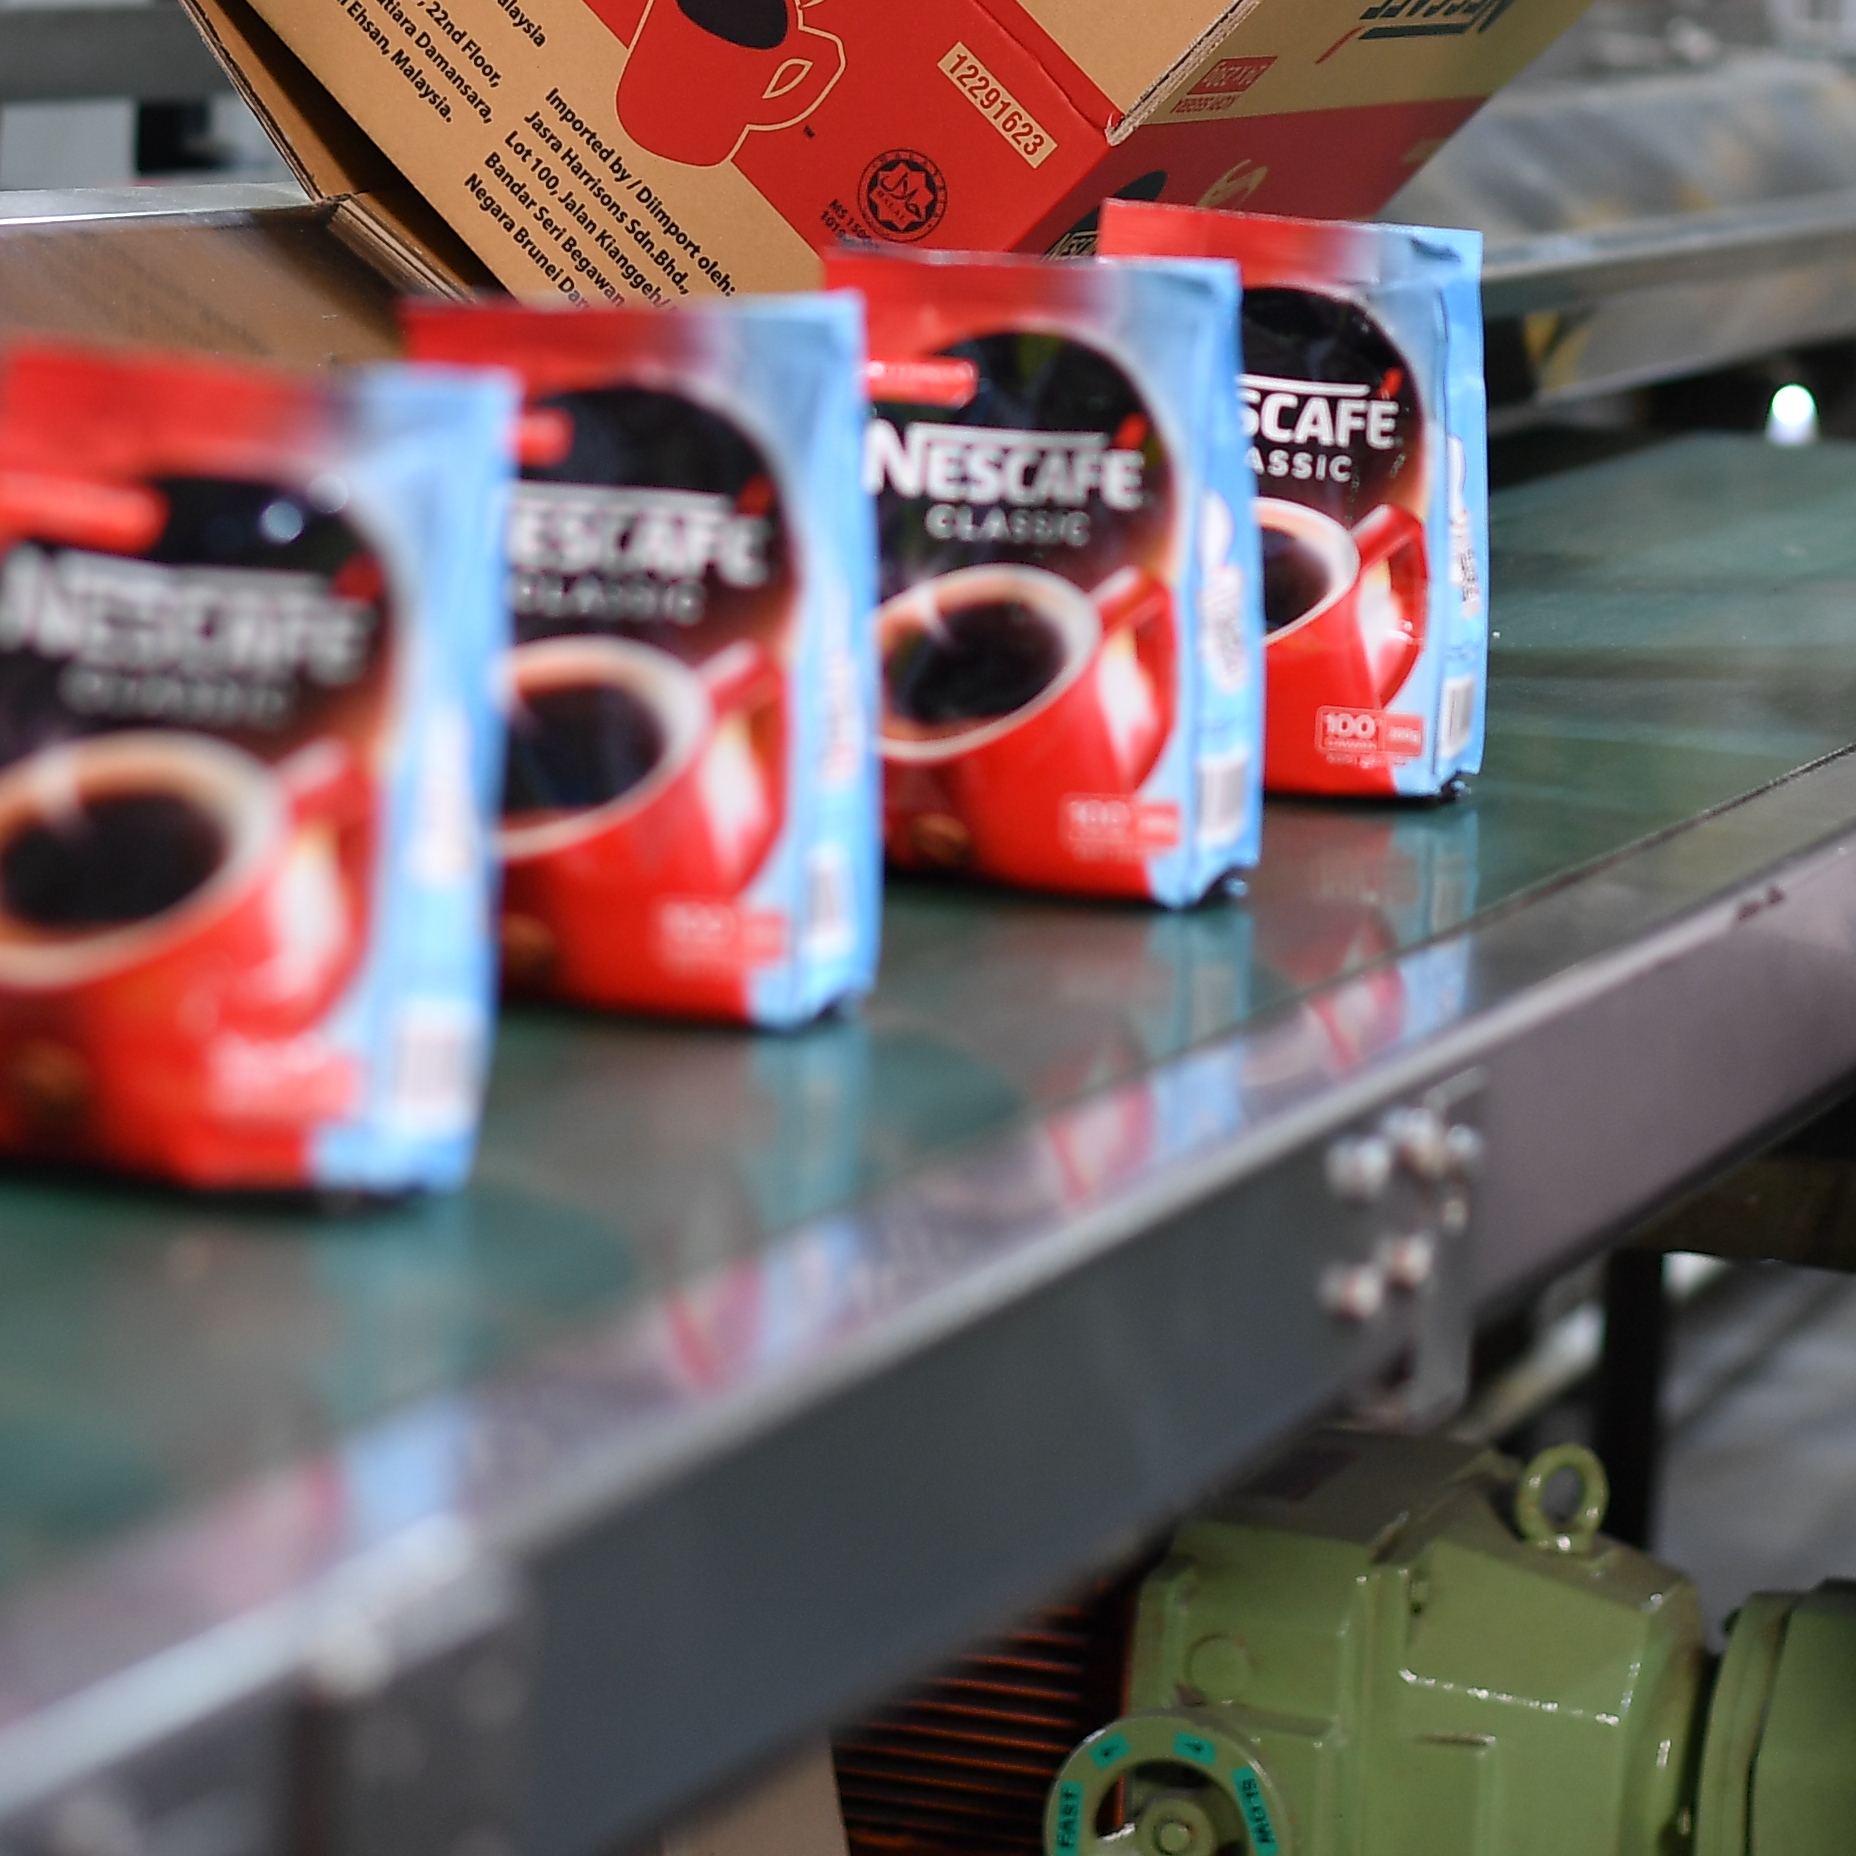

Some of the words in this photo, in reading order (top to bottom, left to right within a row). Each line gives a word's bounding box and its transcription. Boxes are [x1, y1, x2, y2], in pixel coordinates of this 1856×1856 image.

[345, 0, 390, 56] Ehsan,
[389, 47, 452, 124] Malaysia.
[413, 30, 492, 124] Damansara,
[424, 0, 468, 45] 22nd
[459, 38, 502, 88] Floor,
[948, 52, 1046, 156] 12291623
[463, 172, 516, 233] Negara
[511, 225, 565, 282] Brunei
[483, 150, 538, 210] Bandar
[531, 205, 567, 242] Seri
[560, 234, 626, 308] Begawan
[503, 129, 533, 163] Lot
[529, 157, 560, 196] 100,
[556, 190, 597, 235] Jalan
[522, 110, 563, 154] Jasra
[559, 146, 629, 224] Harrisons
[623, 218, 689, 296] Sdn.Bhd.,
[544, 87, 616, 164] Imported
[607, 155, 632, 183] by
[634, 185, 702, 260] Diimport
[696, 255, 736, 297] oleh:
[1247, 448, 1354, 483] ASSIC
[925, 504, 1091, 545] CLASSIC
[1324, 712, 1377, 740] 100
